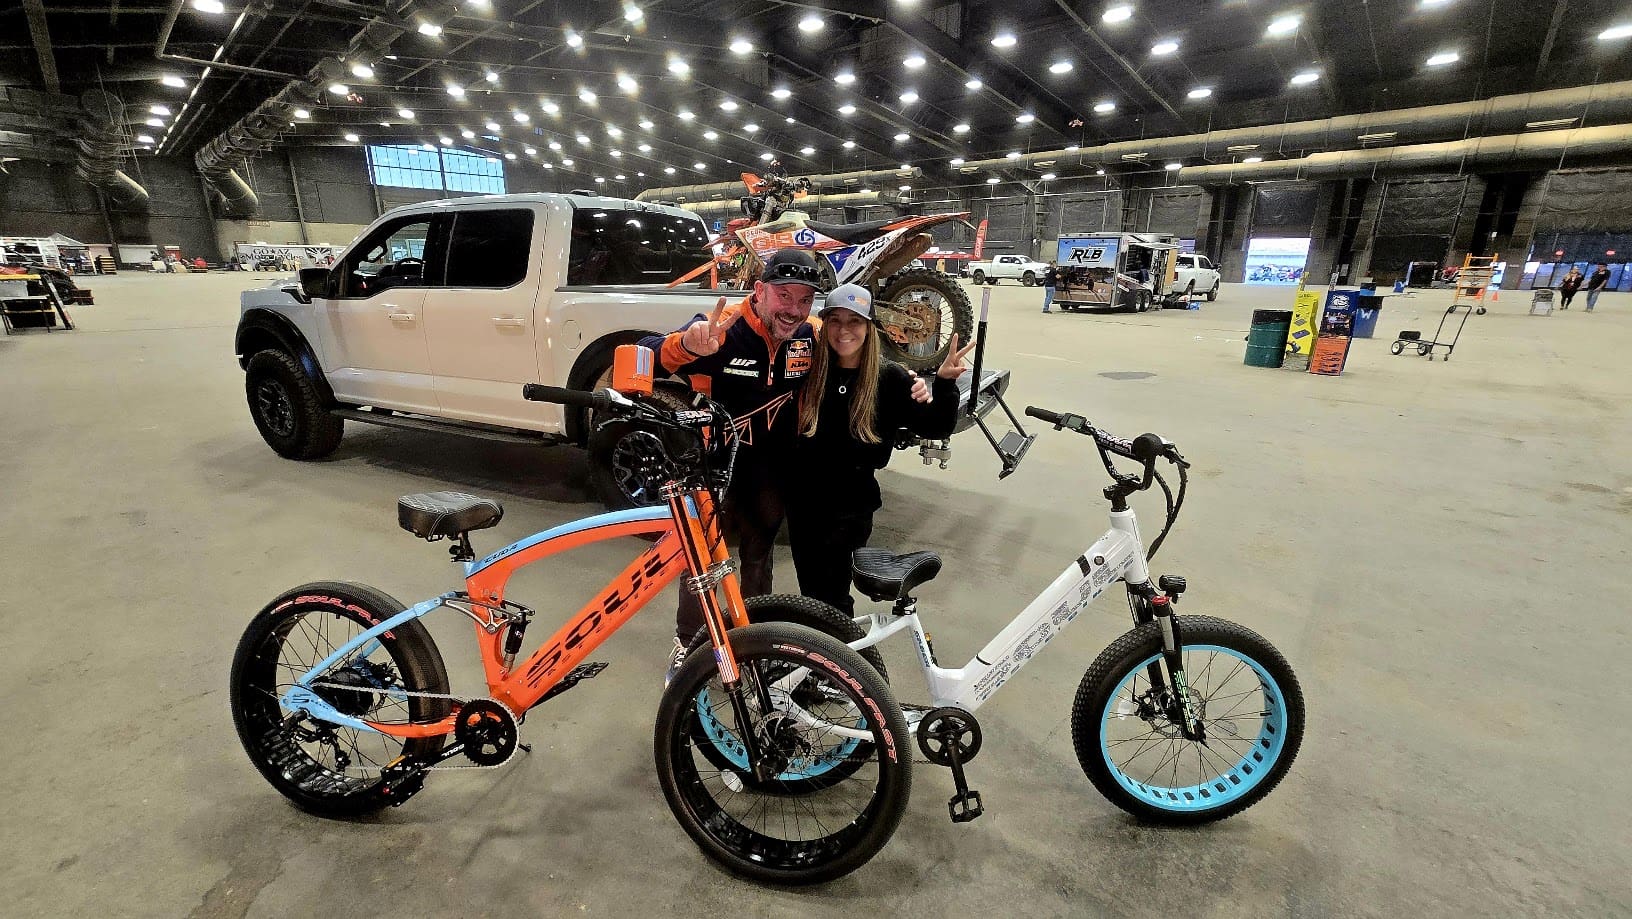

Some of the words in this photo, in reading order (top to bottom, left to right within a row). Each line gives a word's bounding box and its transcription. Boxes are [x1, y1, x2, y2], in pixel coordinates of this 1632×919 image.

[1070, 248, 1103, 264] RLB
[1360, 308, 1372, 320] W
[526, 547, 685, 688] SOUL
[974, 550, 1135, 702] SOUL
[806, 652, 865, 698] SOUL
[863, 697, 898, 764] FAST
